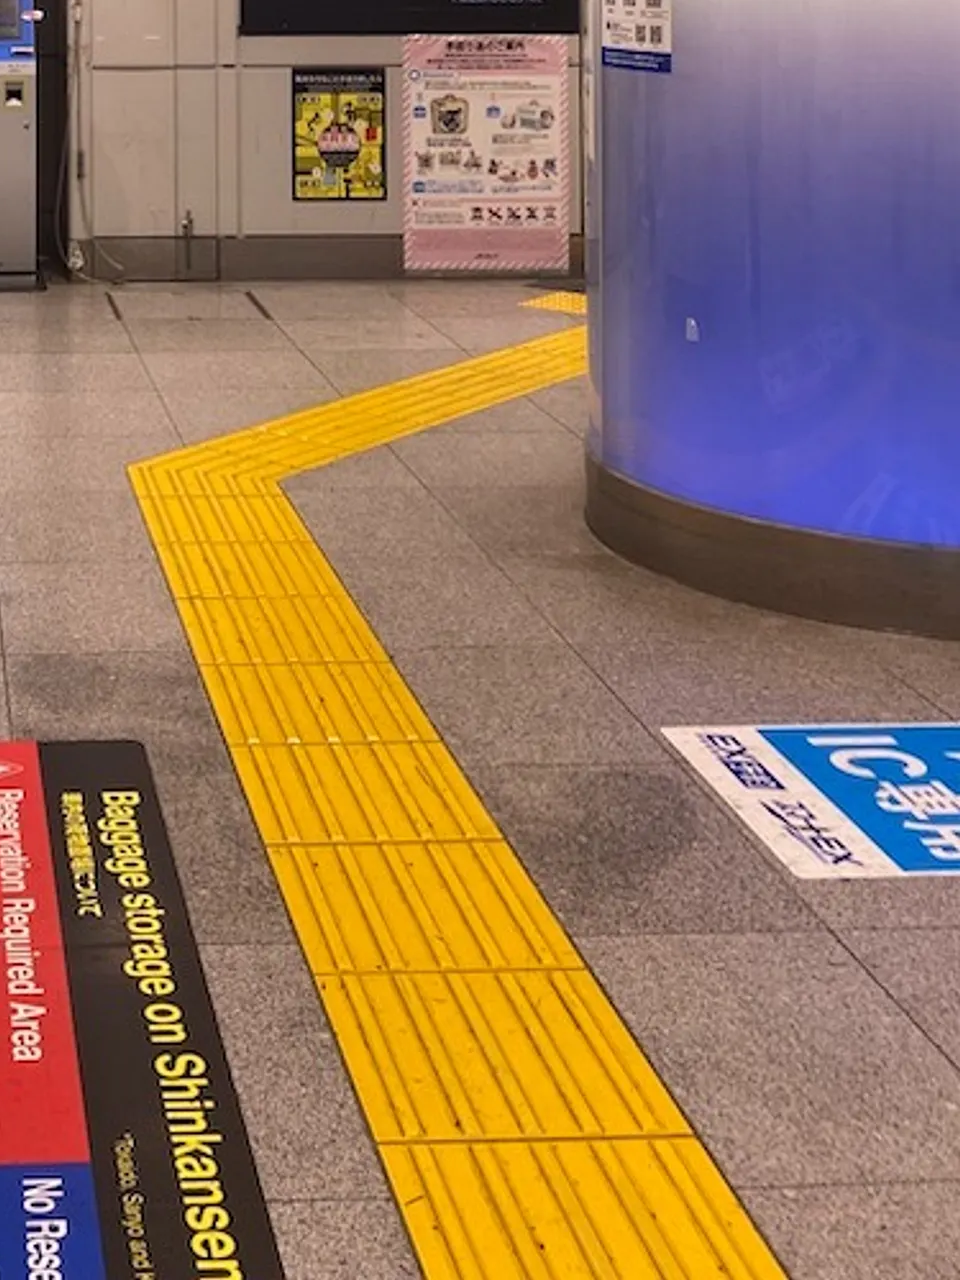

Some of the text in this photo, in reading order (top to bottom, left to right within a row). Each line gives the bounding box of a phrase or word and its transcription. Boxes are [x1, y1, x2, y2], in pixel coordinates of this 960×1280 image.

[8, 1001, 44, 1061] Area
[97, 789, 243, 1280] Baggage storage on Shinkansen
[22, 1178, 64, 1213] No
